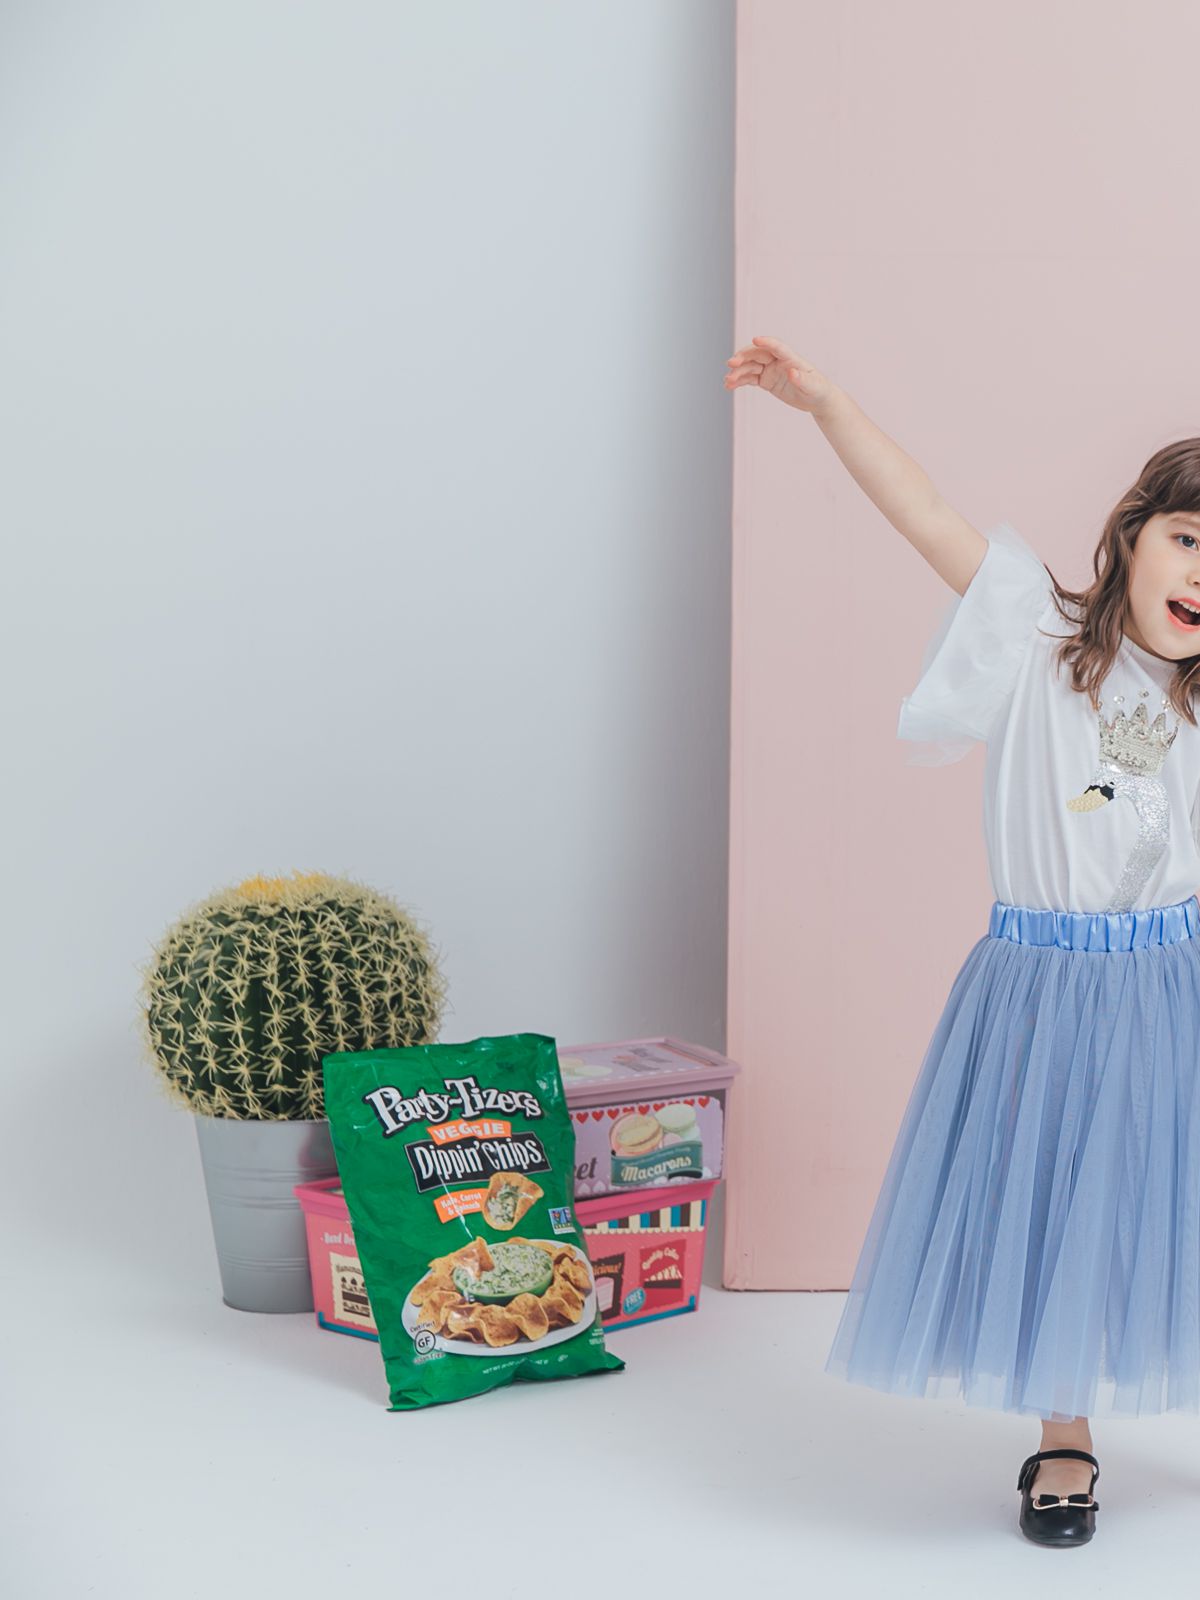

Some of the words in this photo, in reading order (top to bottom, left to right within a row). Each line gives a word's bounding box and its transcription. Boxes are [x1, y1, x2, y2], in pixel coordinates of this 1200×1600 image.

[364, 1076, 542, 1135] Party-Tizers
[433, 1122, 505, 1141] VEGGIE
[413, 1141, 484, 1180] Dippin'
[482, 1138, 542, 1171] Chips
[621, 1156, 692, 1182] Macarons
[417, 1336, 430, 1348] GF
